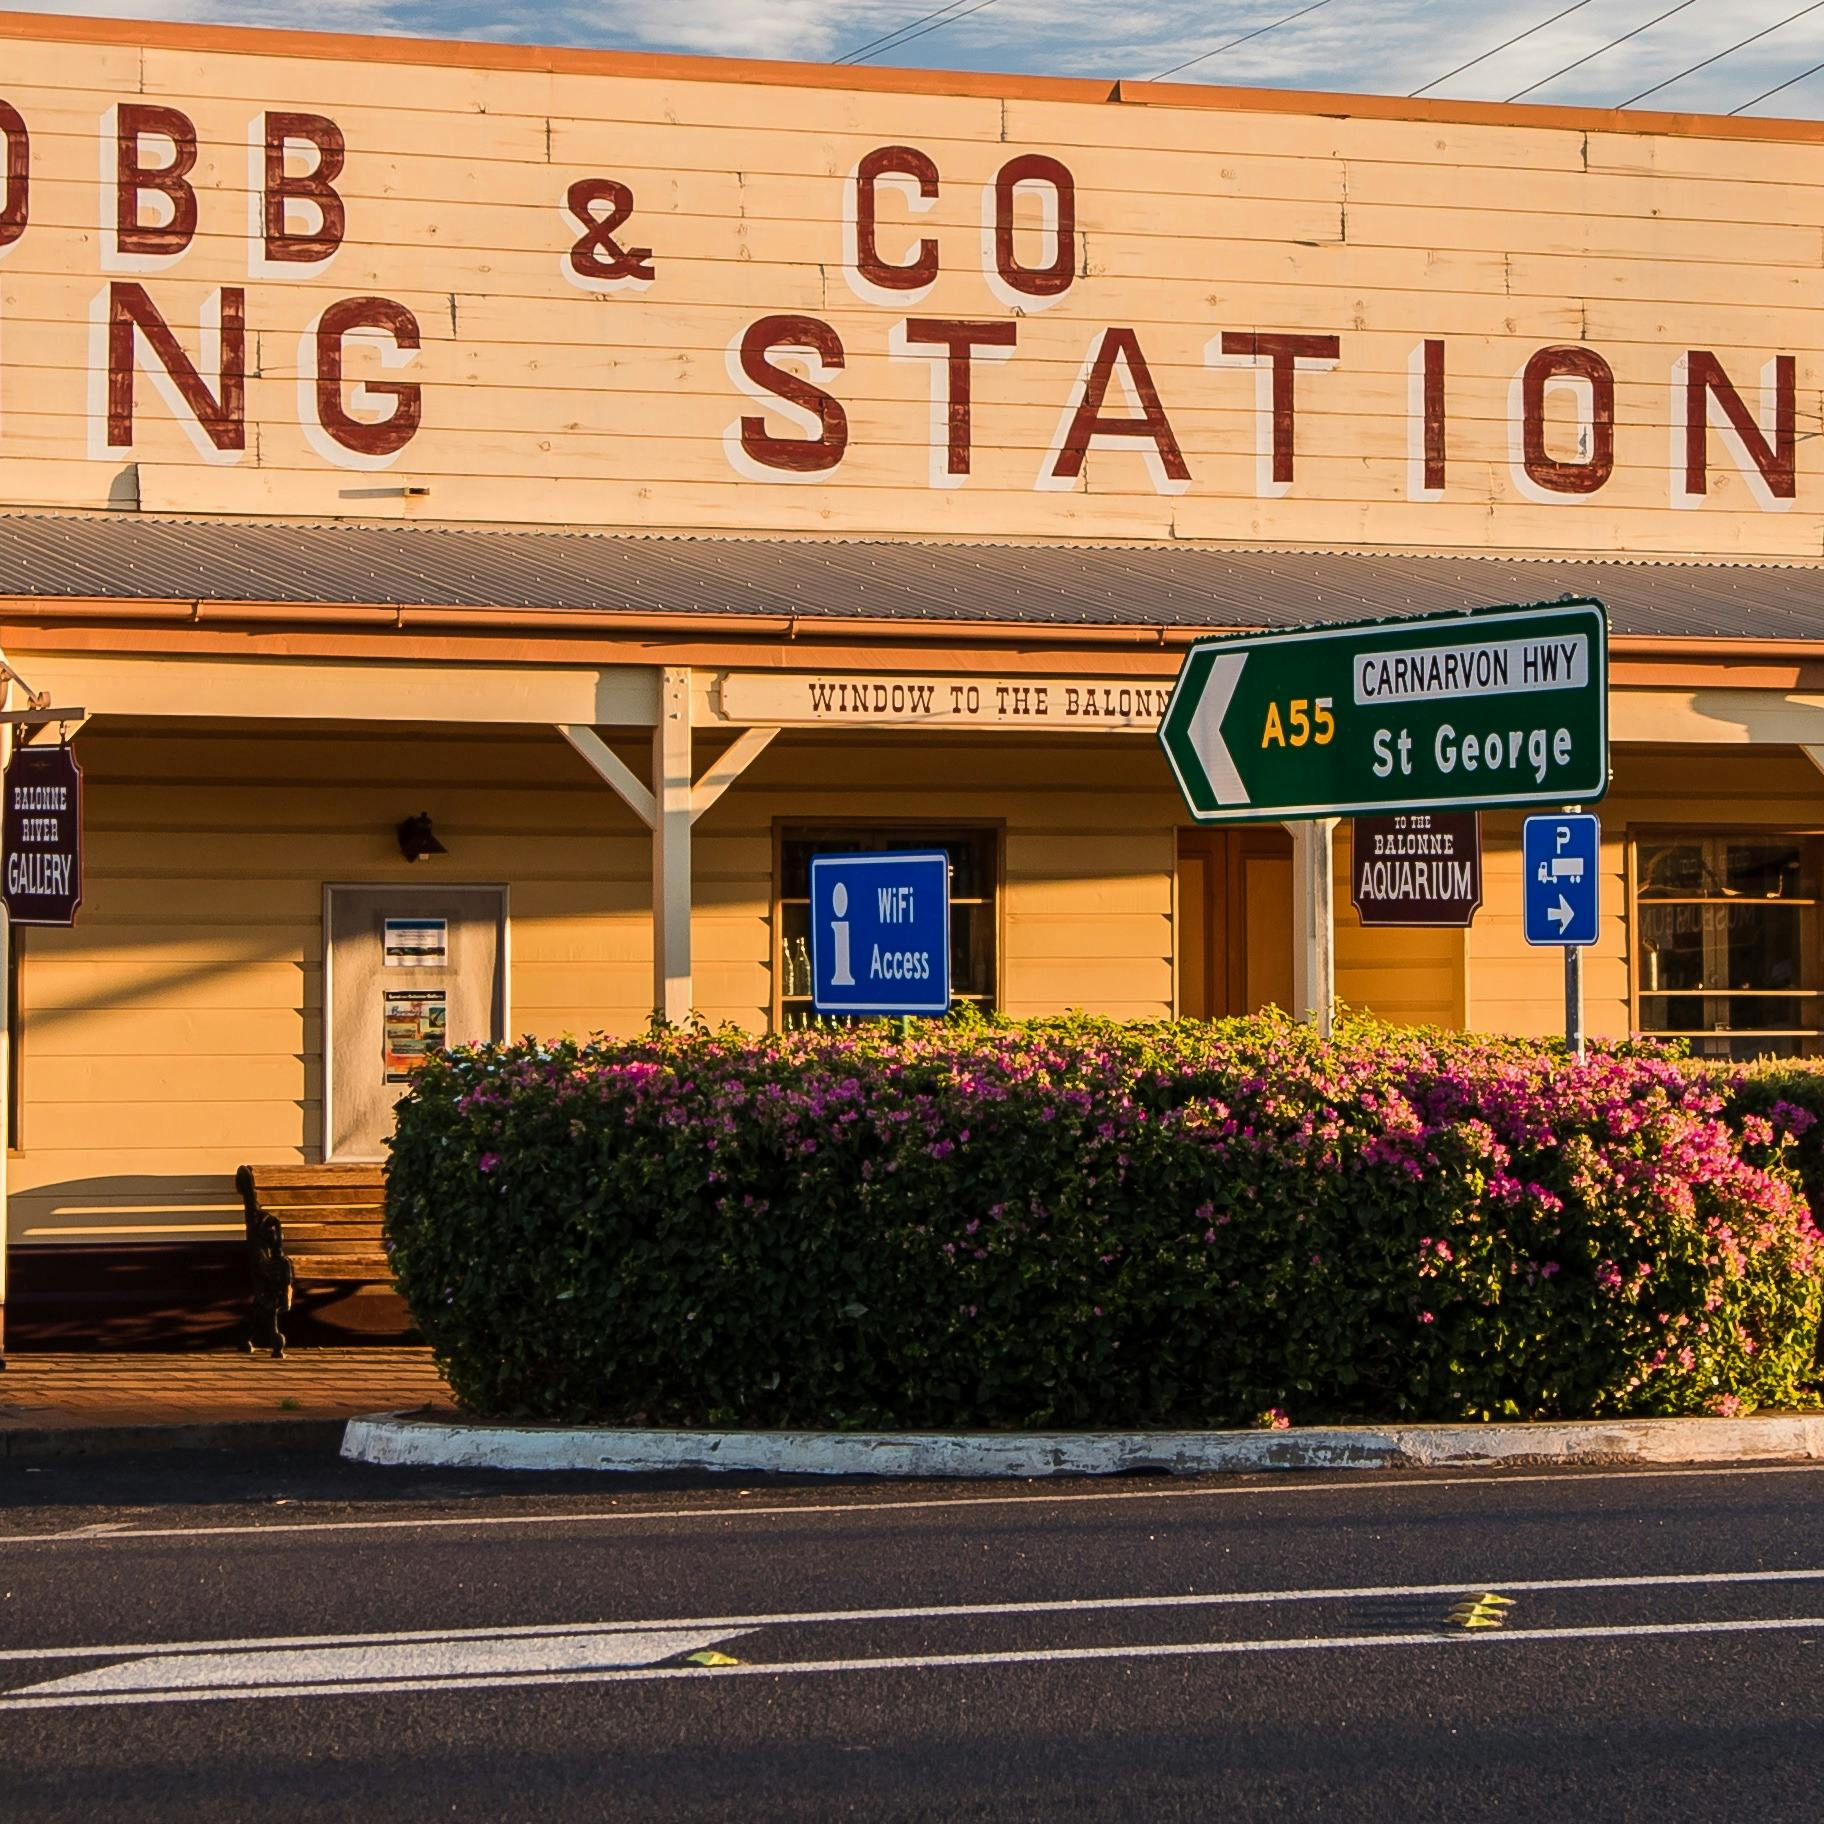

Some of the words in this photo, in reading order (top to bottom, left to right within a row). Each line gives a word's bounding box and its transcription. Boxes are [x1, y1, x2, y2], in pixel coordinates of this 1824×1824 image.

[567, 178, 655, 280] &
[856, 145, 1077, 296] CO
[740, 314, 1797, 499] STATION
[1362, 649, 1508, 697] CARNARVON
[1524, 642, 1578, 684] HWY
[809, 683, 935, 714] WINDOW
[950, 686, 980, 714] TO
[996, 687, 1048, 715] THE
[1261, 698, 1335, 748] A55
[1372, 729, 1412, 777] St
[1435, 724, 1572, 783] George
[14, 786, 67, 811] BALONNE
[22, 819, 59, 842] RIVER
[1395, 816, 1406, 829] TO
[1411, 816, 1431, 829] THE
[1556, 827, 1570, 854] P
[1375, 834, 1454, 855] BALONNE
[8, 852, 72, 895] GALLERY
[1359, 861, 1472, 900] AQUARIUM
[878, 887, 914, 923] WiFi
[870, 944, 930, 979] Access
